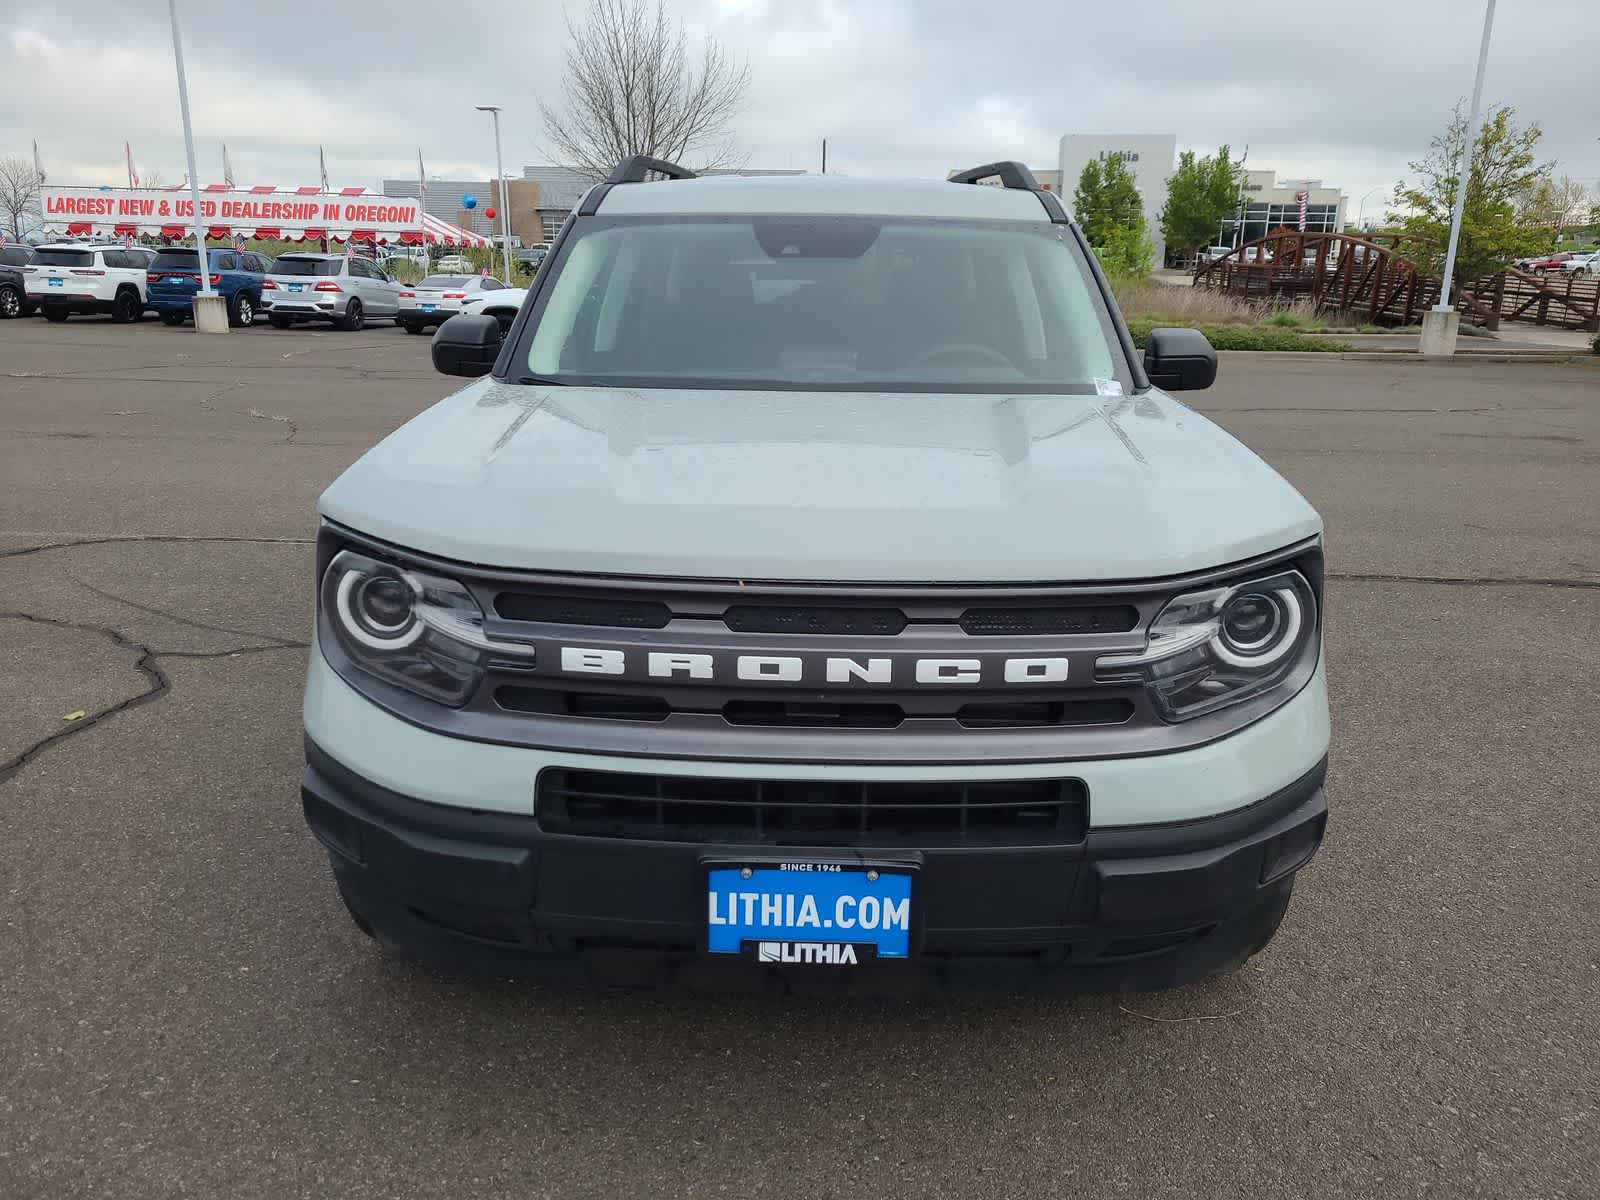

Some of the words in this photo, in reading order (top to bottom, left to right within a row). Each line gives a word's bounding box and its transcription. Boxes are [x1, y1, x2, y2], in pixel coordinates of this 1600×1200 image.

[46, 196, 115, 215] LARGEST
[118, 200, 154, 216] NEW
[157, 199, 171, 217] &
[221, 201, 319, 221] DEALERSHIP
[323, 204, 340, 221] IN
[344, 204, 416, 223] OREGON!
[560, 646, 1070, 684] BRONCO
[780, 863, 812, 871] SINCE
[816, 864, 842, 872] 1946
[708, 891, 910, 930] LITHIA.COM
[781, 943, 858, 965] LITHIA
